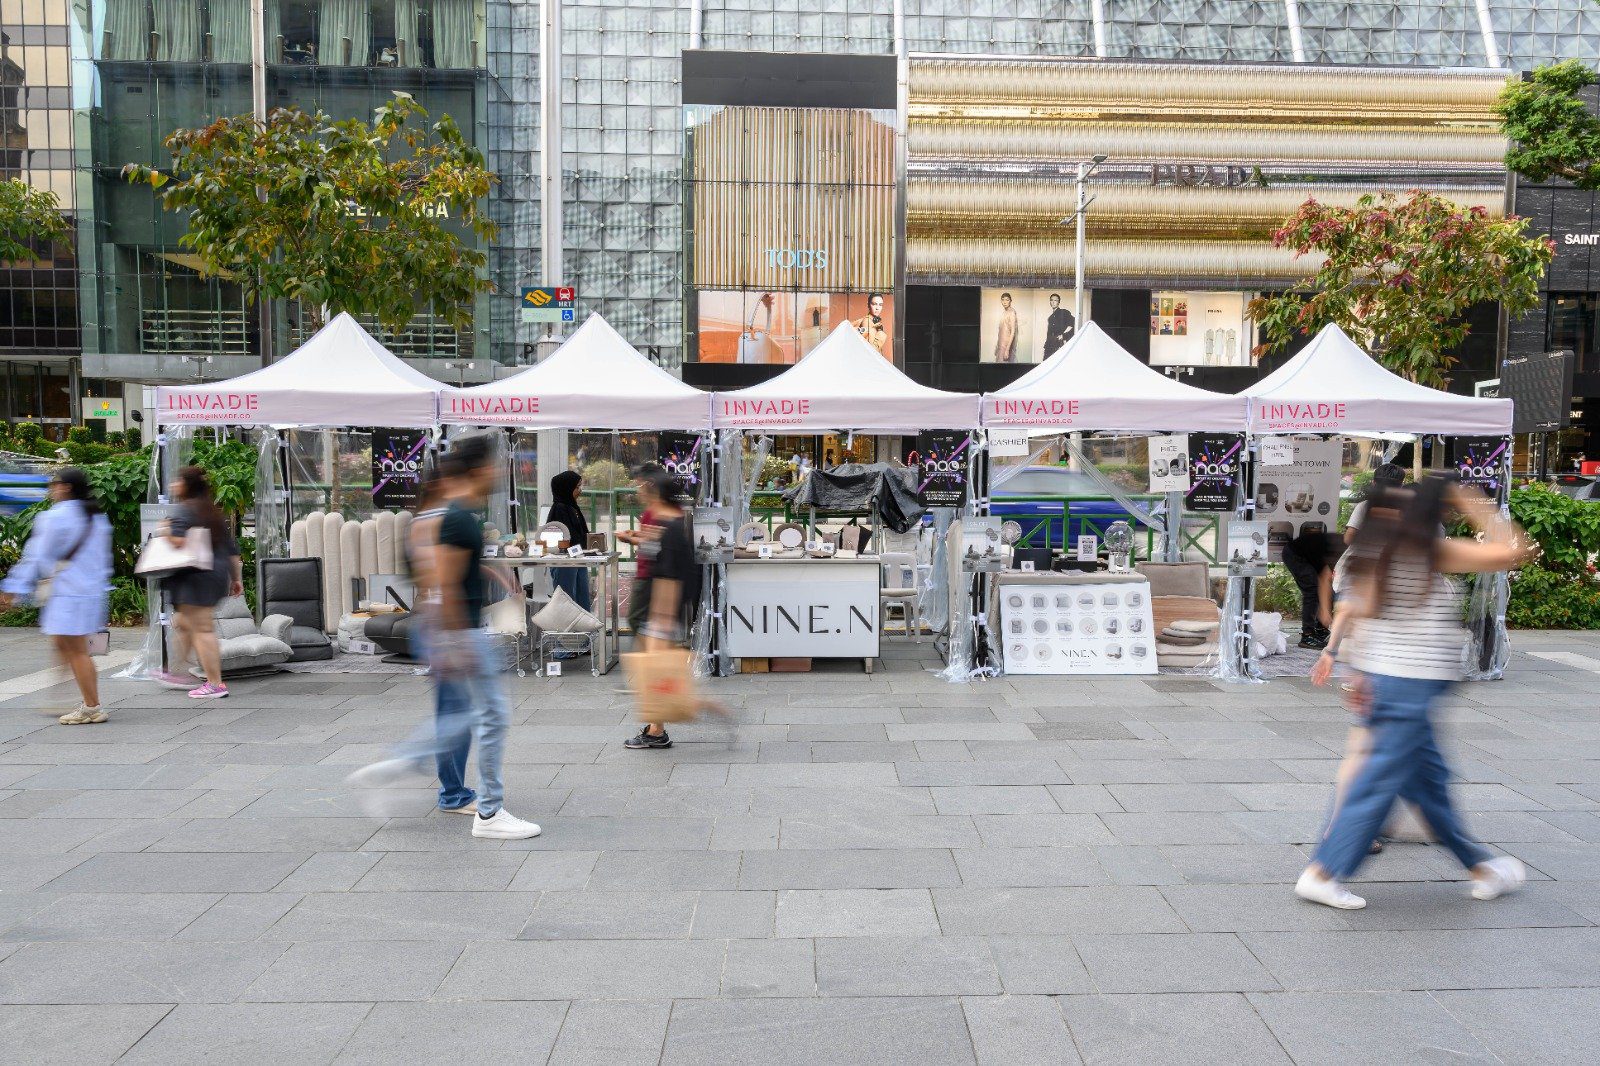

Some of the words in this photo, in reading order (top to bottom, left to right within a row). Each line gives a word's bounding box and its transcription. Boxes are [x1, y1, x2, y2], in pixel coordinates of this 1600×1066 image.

[1151, 163, 1268, 187] PRADA
[1564, 233, 1599, 245] SAINT
[762, 249, 828, 269] TOD'S
[168, 394, 258, 410] INVADE
[452, 398, 540, 413] INVADE
[724, 400, 810, 415] INVADE
[994, 400, 1079, 414] INVADE
[1261, 403, 1346, 419] INVADE
[990, 438, 1027, 446] CASHIER
[730, 605, 873, 633] NINE.N
